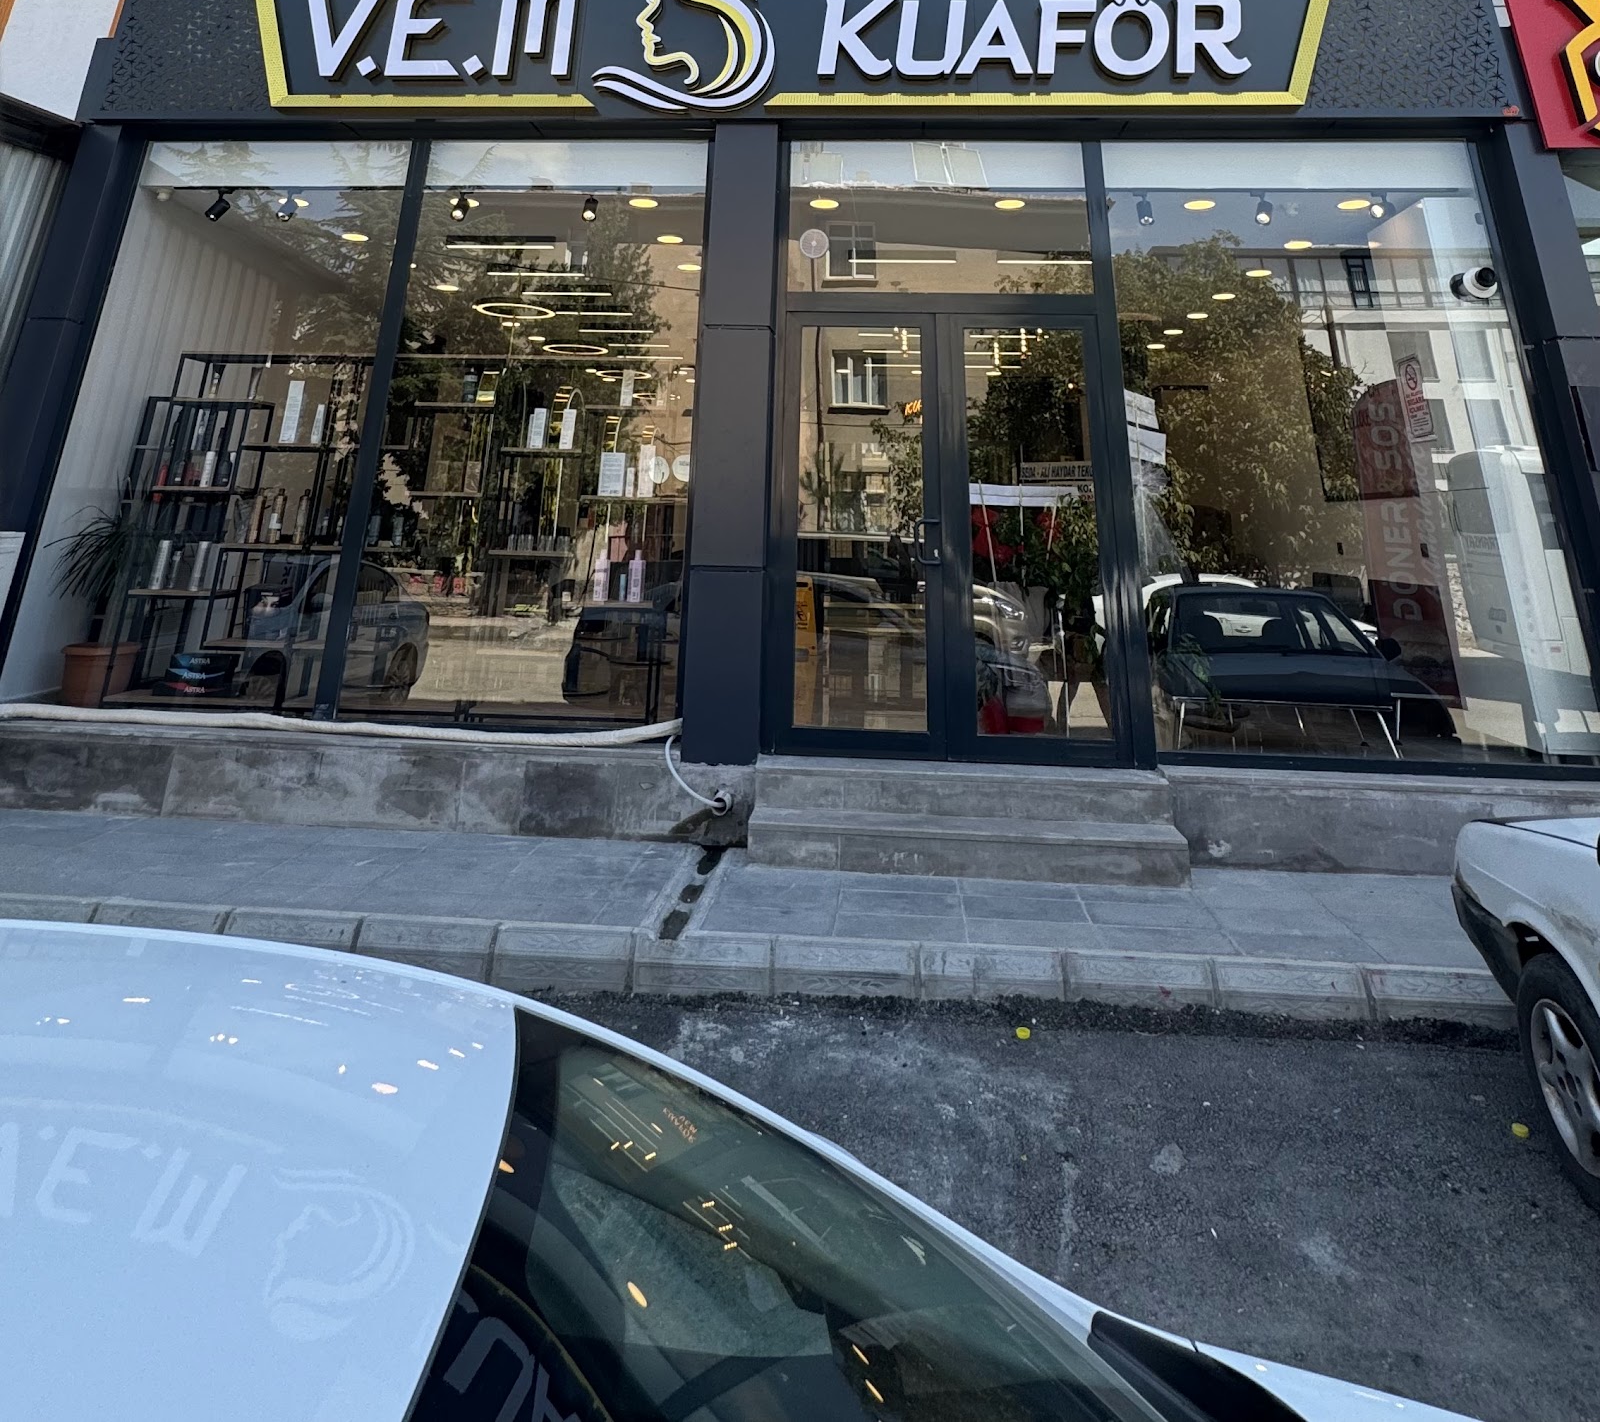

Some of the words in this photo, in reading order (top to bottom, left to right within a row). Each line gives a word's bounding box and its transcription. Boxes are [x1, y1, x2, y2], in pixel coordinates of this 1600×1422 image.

[189, 657, 211, 665] ASTRA
[181, 671, 206, 680] ASTRA
[183, 686, 206, 694] ASTRA
